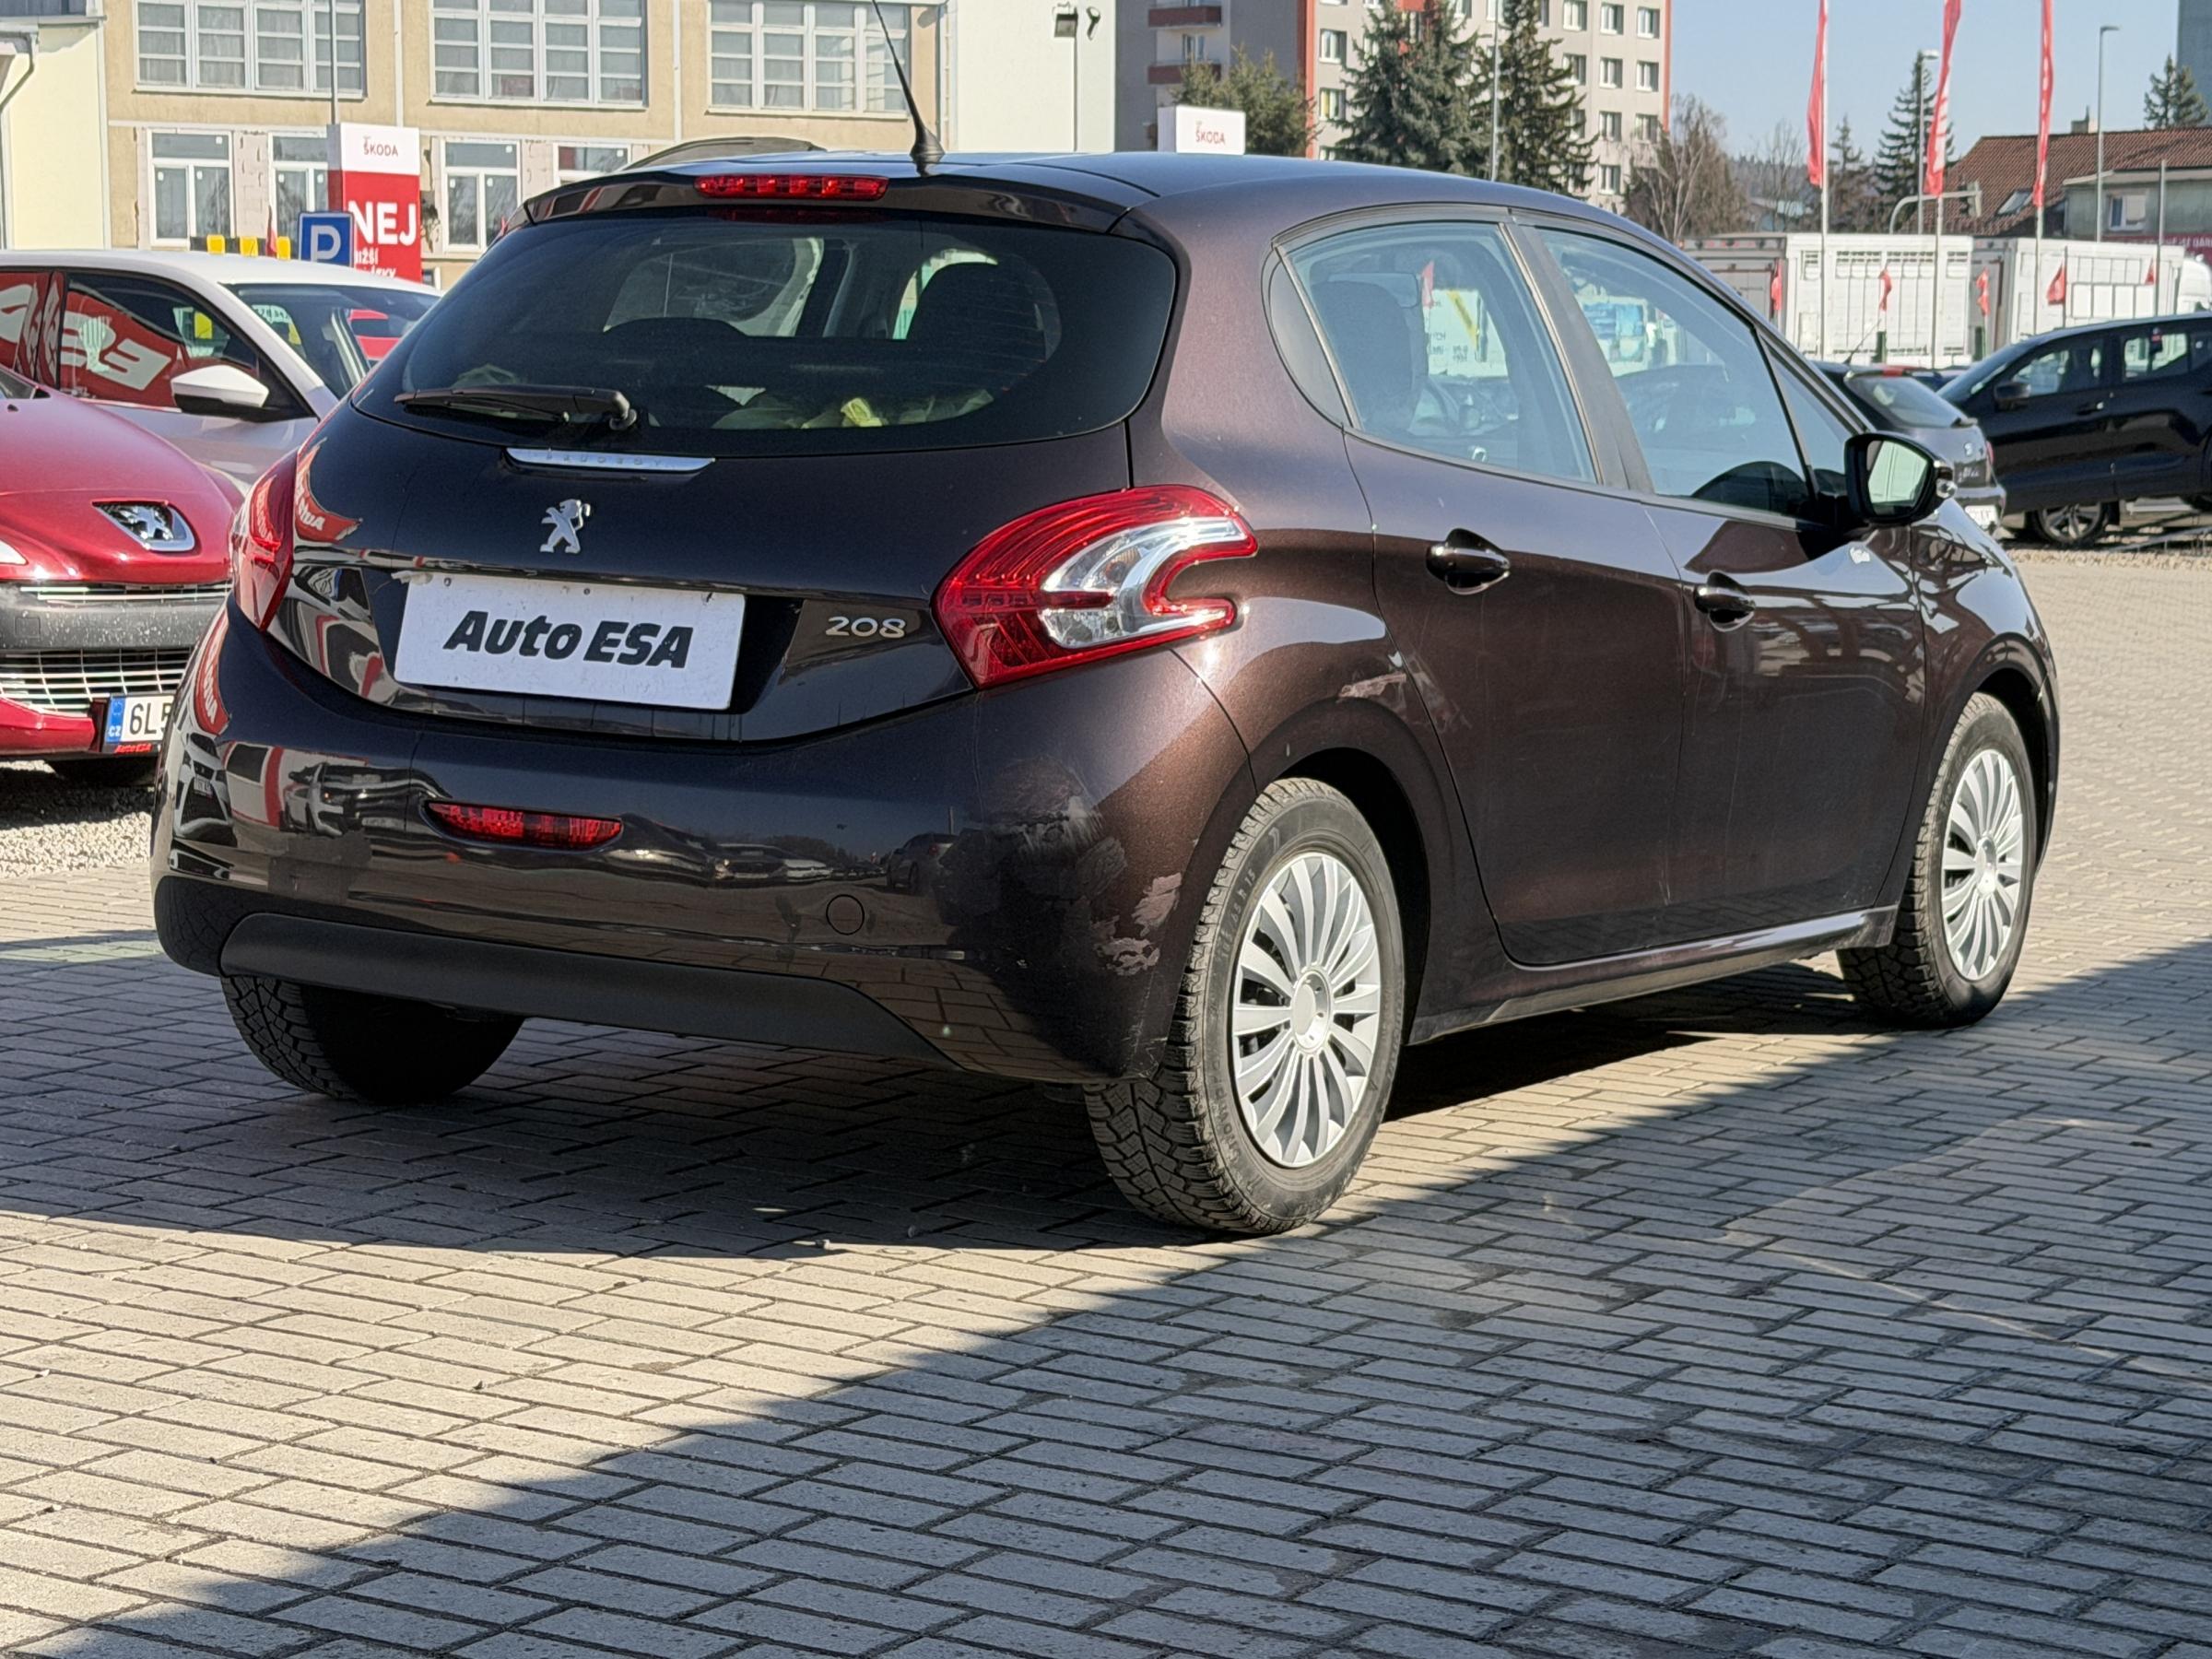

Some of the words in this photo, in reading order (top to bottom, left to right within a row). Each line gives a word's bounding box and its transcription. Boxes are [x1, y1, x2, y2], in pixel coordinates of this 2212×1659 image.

[363, 138, 398, 157] ŠKODA
[347, 200, 417, 246] NEJ
[310, 224, 342, 263] P
[442, 610, 582, 660] Auto
[582, 620, 694, 668] ESA
[825, 616, 906, 639] 208
[108, 725, 122, 737] CZ
